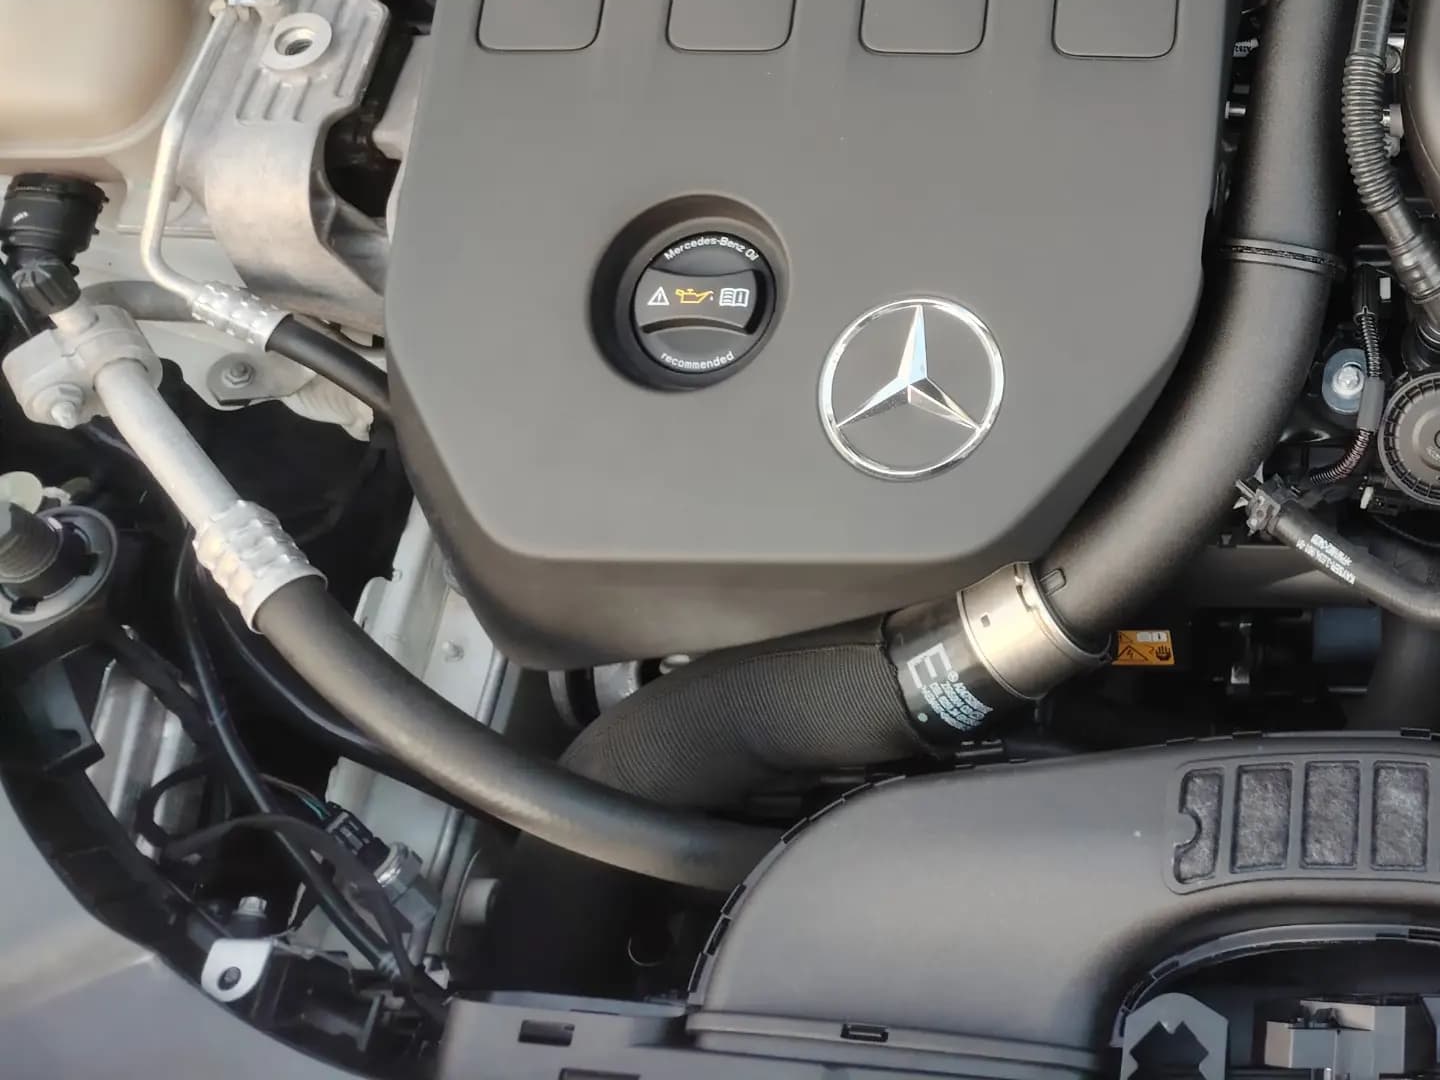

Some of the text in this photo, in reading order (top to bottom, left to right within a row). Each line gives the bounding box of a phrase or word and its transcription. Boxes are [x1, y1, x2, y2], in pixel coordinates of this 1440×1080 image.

[664, 237, 760, 262] Mercedes-Benz Oil
[661, 350, 735, 369] recommended
